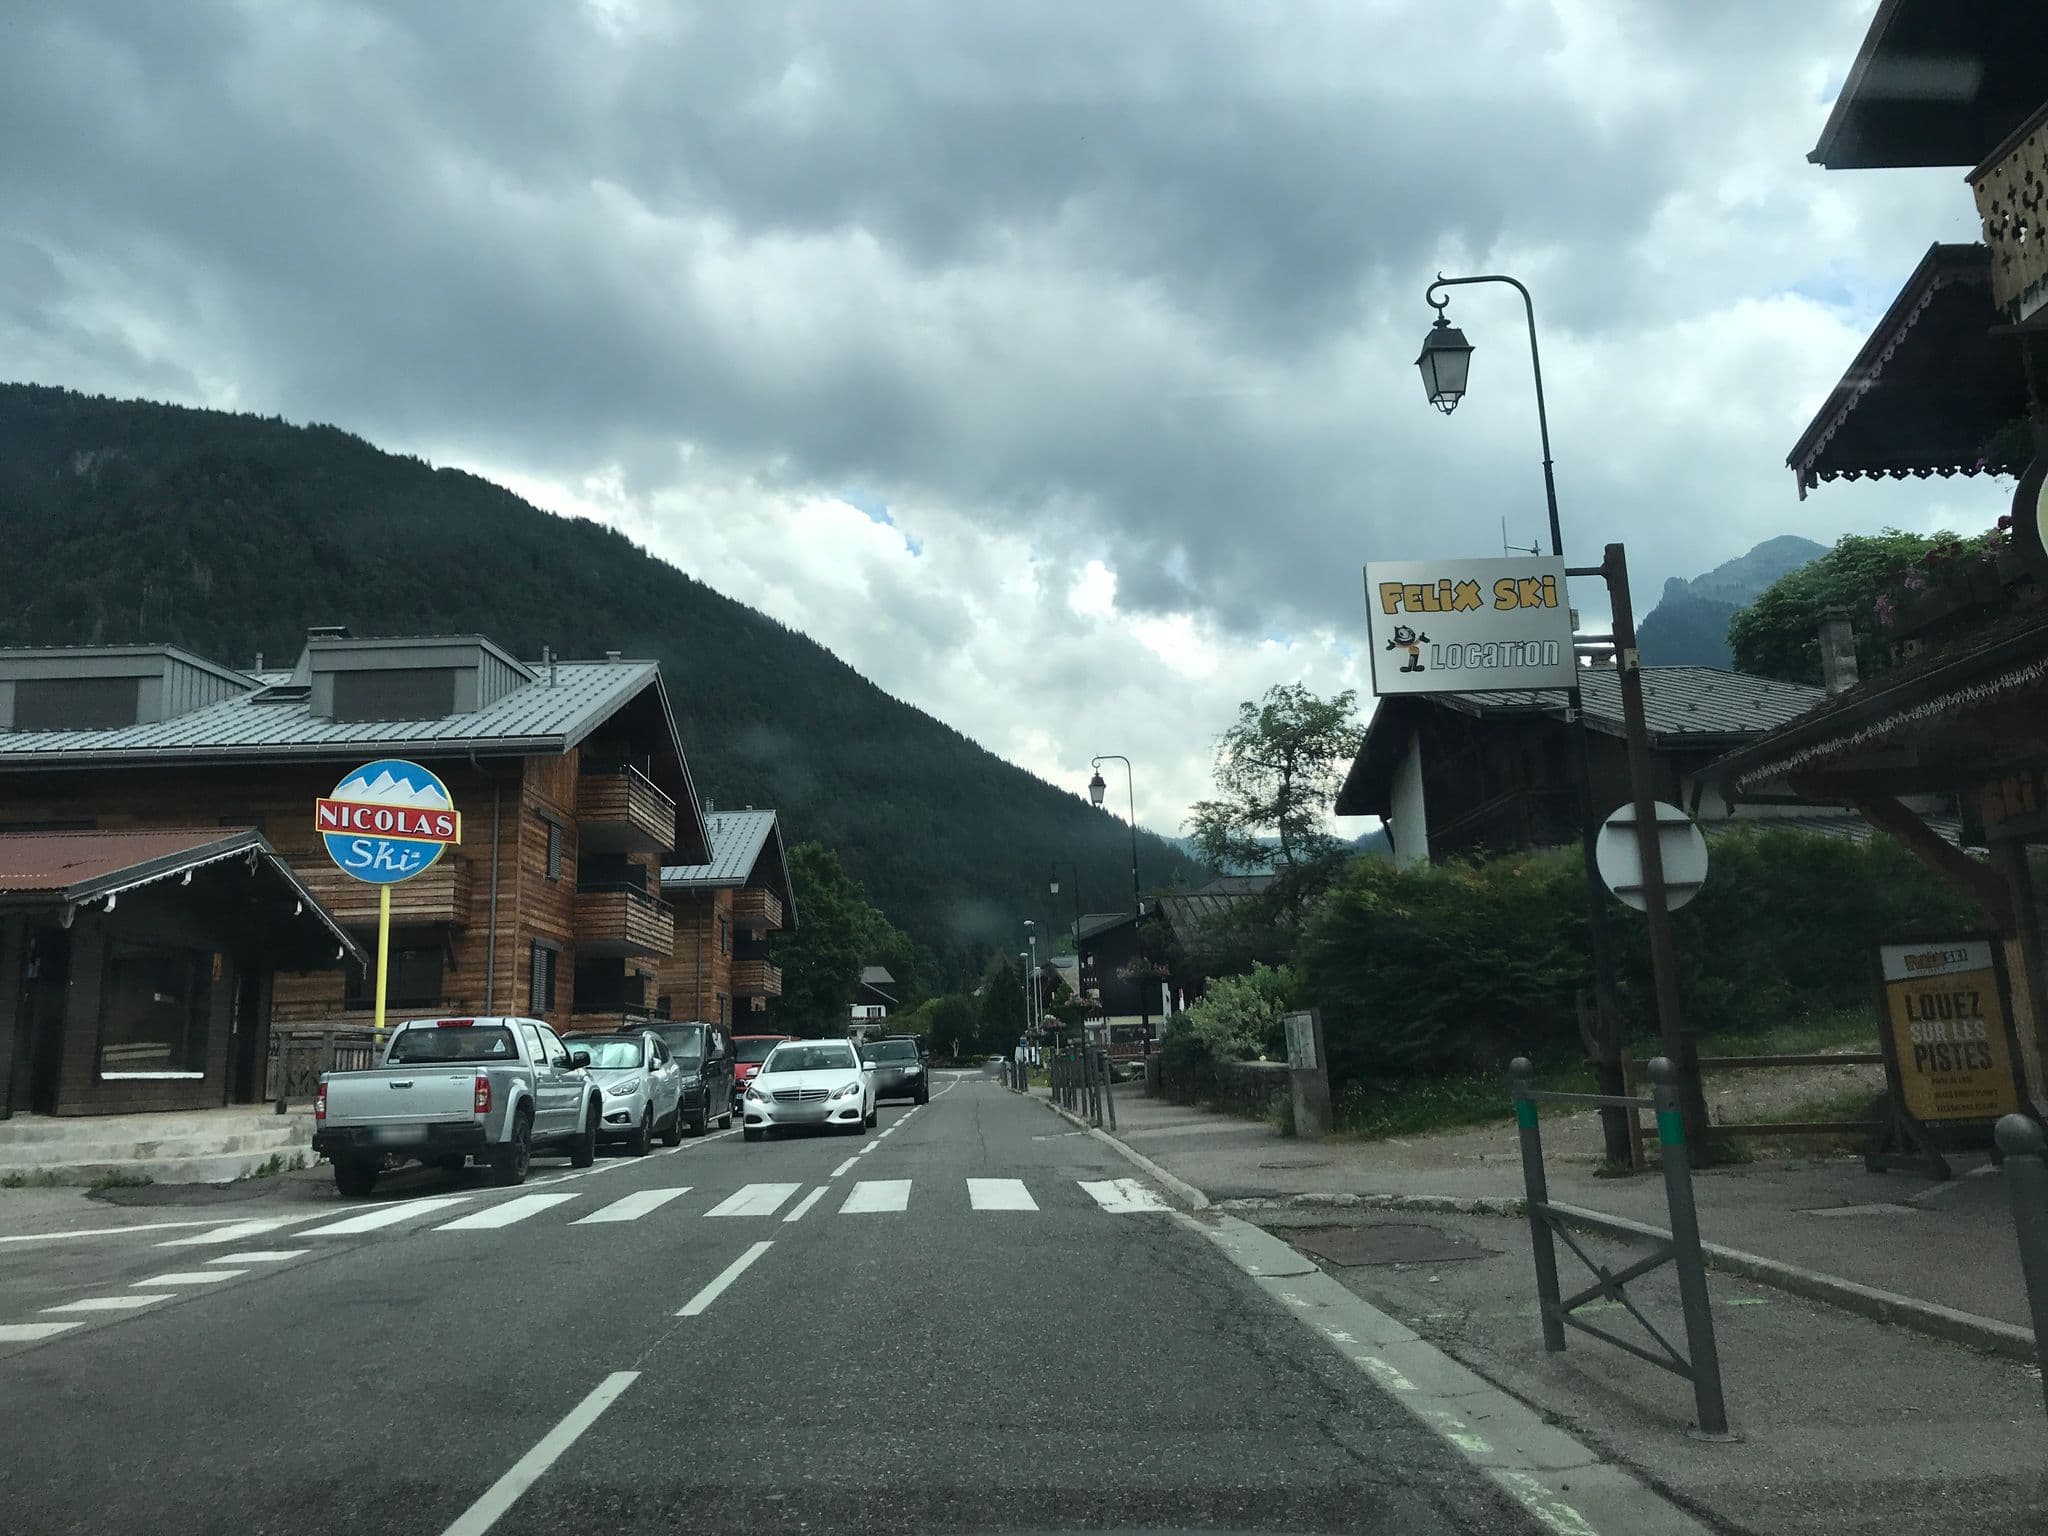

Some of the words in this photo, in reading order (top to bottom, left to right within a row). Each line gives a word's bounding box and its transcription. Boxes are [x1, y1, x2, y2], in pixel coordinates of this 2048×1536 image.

[319, 804, 454, 837] NICOLAS
[344, 839, 421, 872] Ski
[1904, 991, 1984, 1021] LOUEZ
[1910, 1021, 1947, 1043] SUR
[1952, 1020, 1986, 1041] LES
[1913, 1039, 1993, 1073] PISTES
